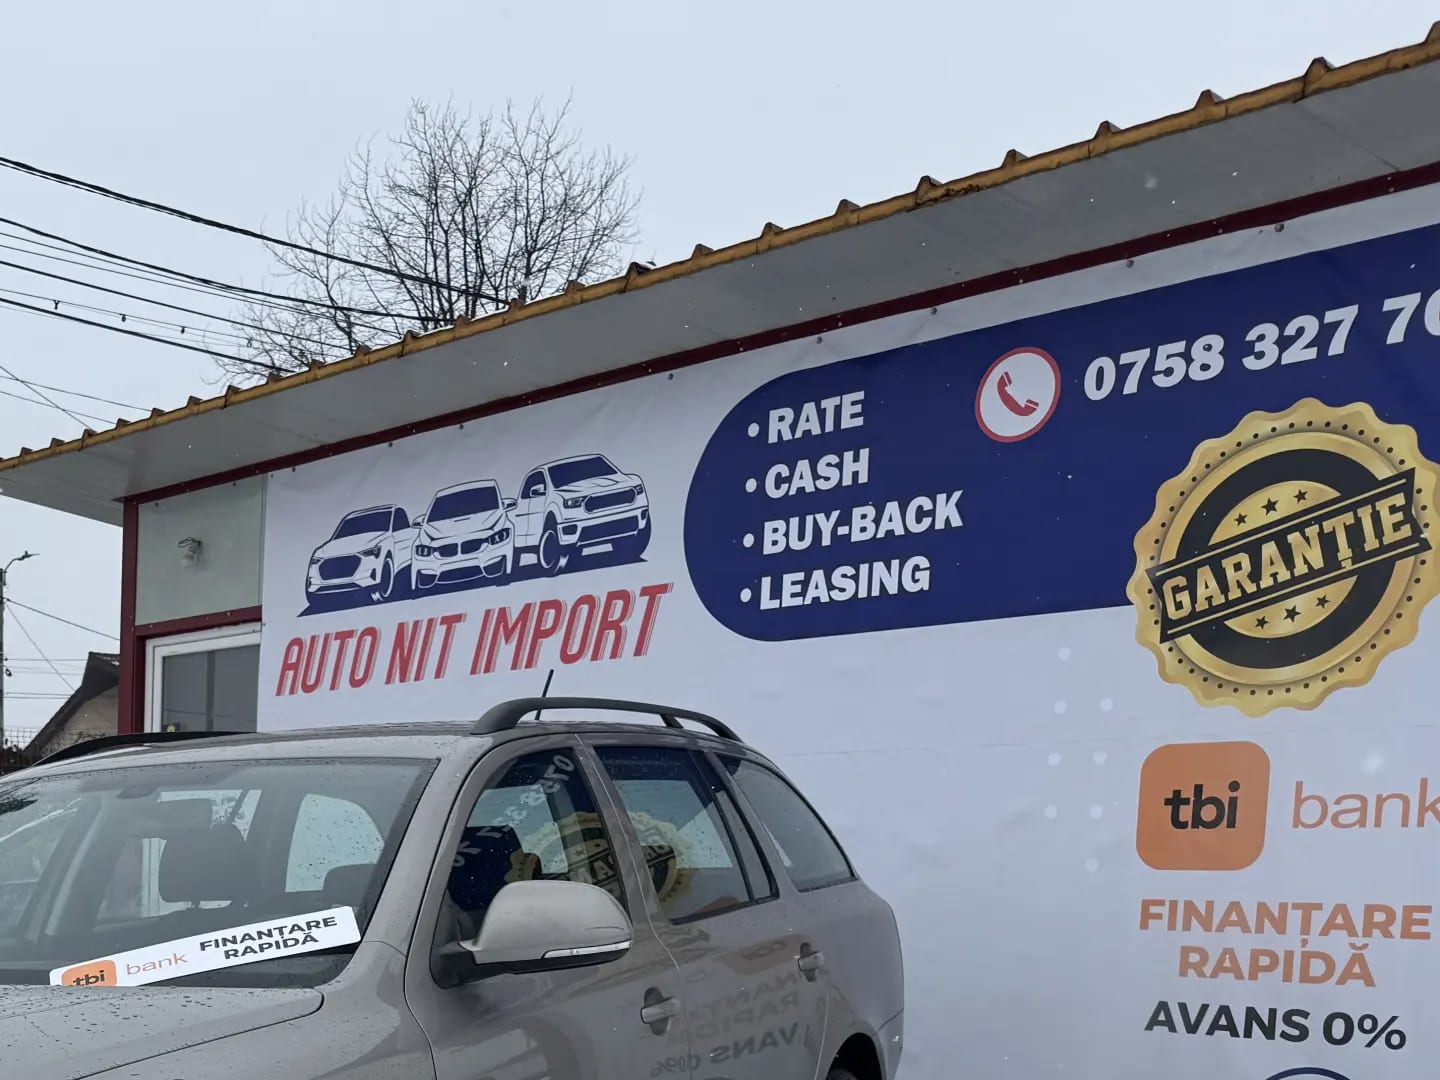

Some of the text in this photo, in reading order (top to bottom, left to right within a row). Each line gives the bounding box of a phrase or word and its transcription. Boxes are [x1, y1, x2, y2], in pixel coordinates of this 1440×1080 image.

[1083, 334, 1225, 401] 0758
[1242, 304, 1359, 370] 327
[768, 390, 865, 444] RATE
[765, 448, 870, 499] CASH
[762, 490, 964, 555] BUY-BACK
[1162, 492, 1412, 620] GARANȚIE
[760, 556, 931, 611] LEASING
[275, 582, 674, 696] AUTO NIT IMPORT
[1164, 777, 1440, 830] tbi bank
[1139, 898, 1433, 947] FINANȚARE
[126, 952, 189, 977] bank
[1178, 938, 1376, 987] RAPIDĂ
[1143, 1000, 1407, 1050] AVANS 0%
